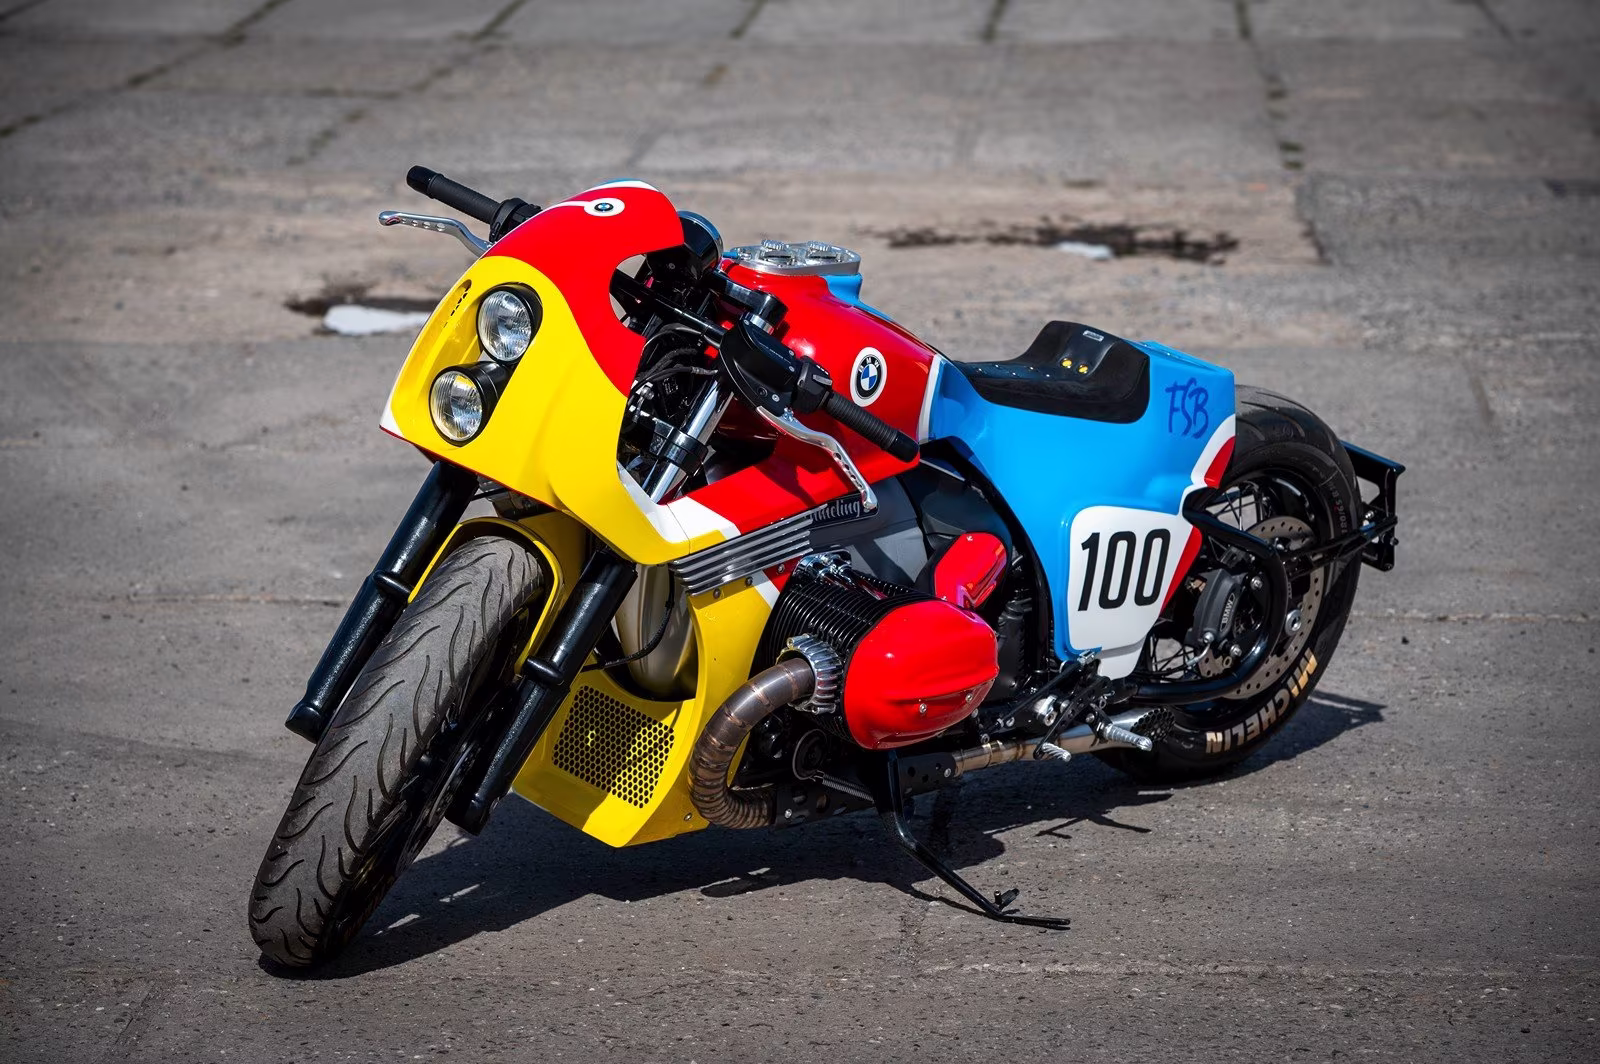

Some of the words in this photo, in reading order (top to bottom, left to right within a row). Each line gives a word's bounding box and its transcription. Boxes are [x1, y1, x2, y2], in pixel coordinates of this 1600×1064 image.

[858, 356, 881, 373] BMW
[1077, 528, 1171, 611] 100
[1221, 599, 1233, 624] BMW
[1205, 647, 1318, 754] MICHELIN
